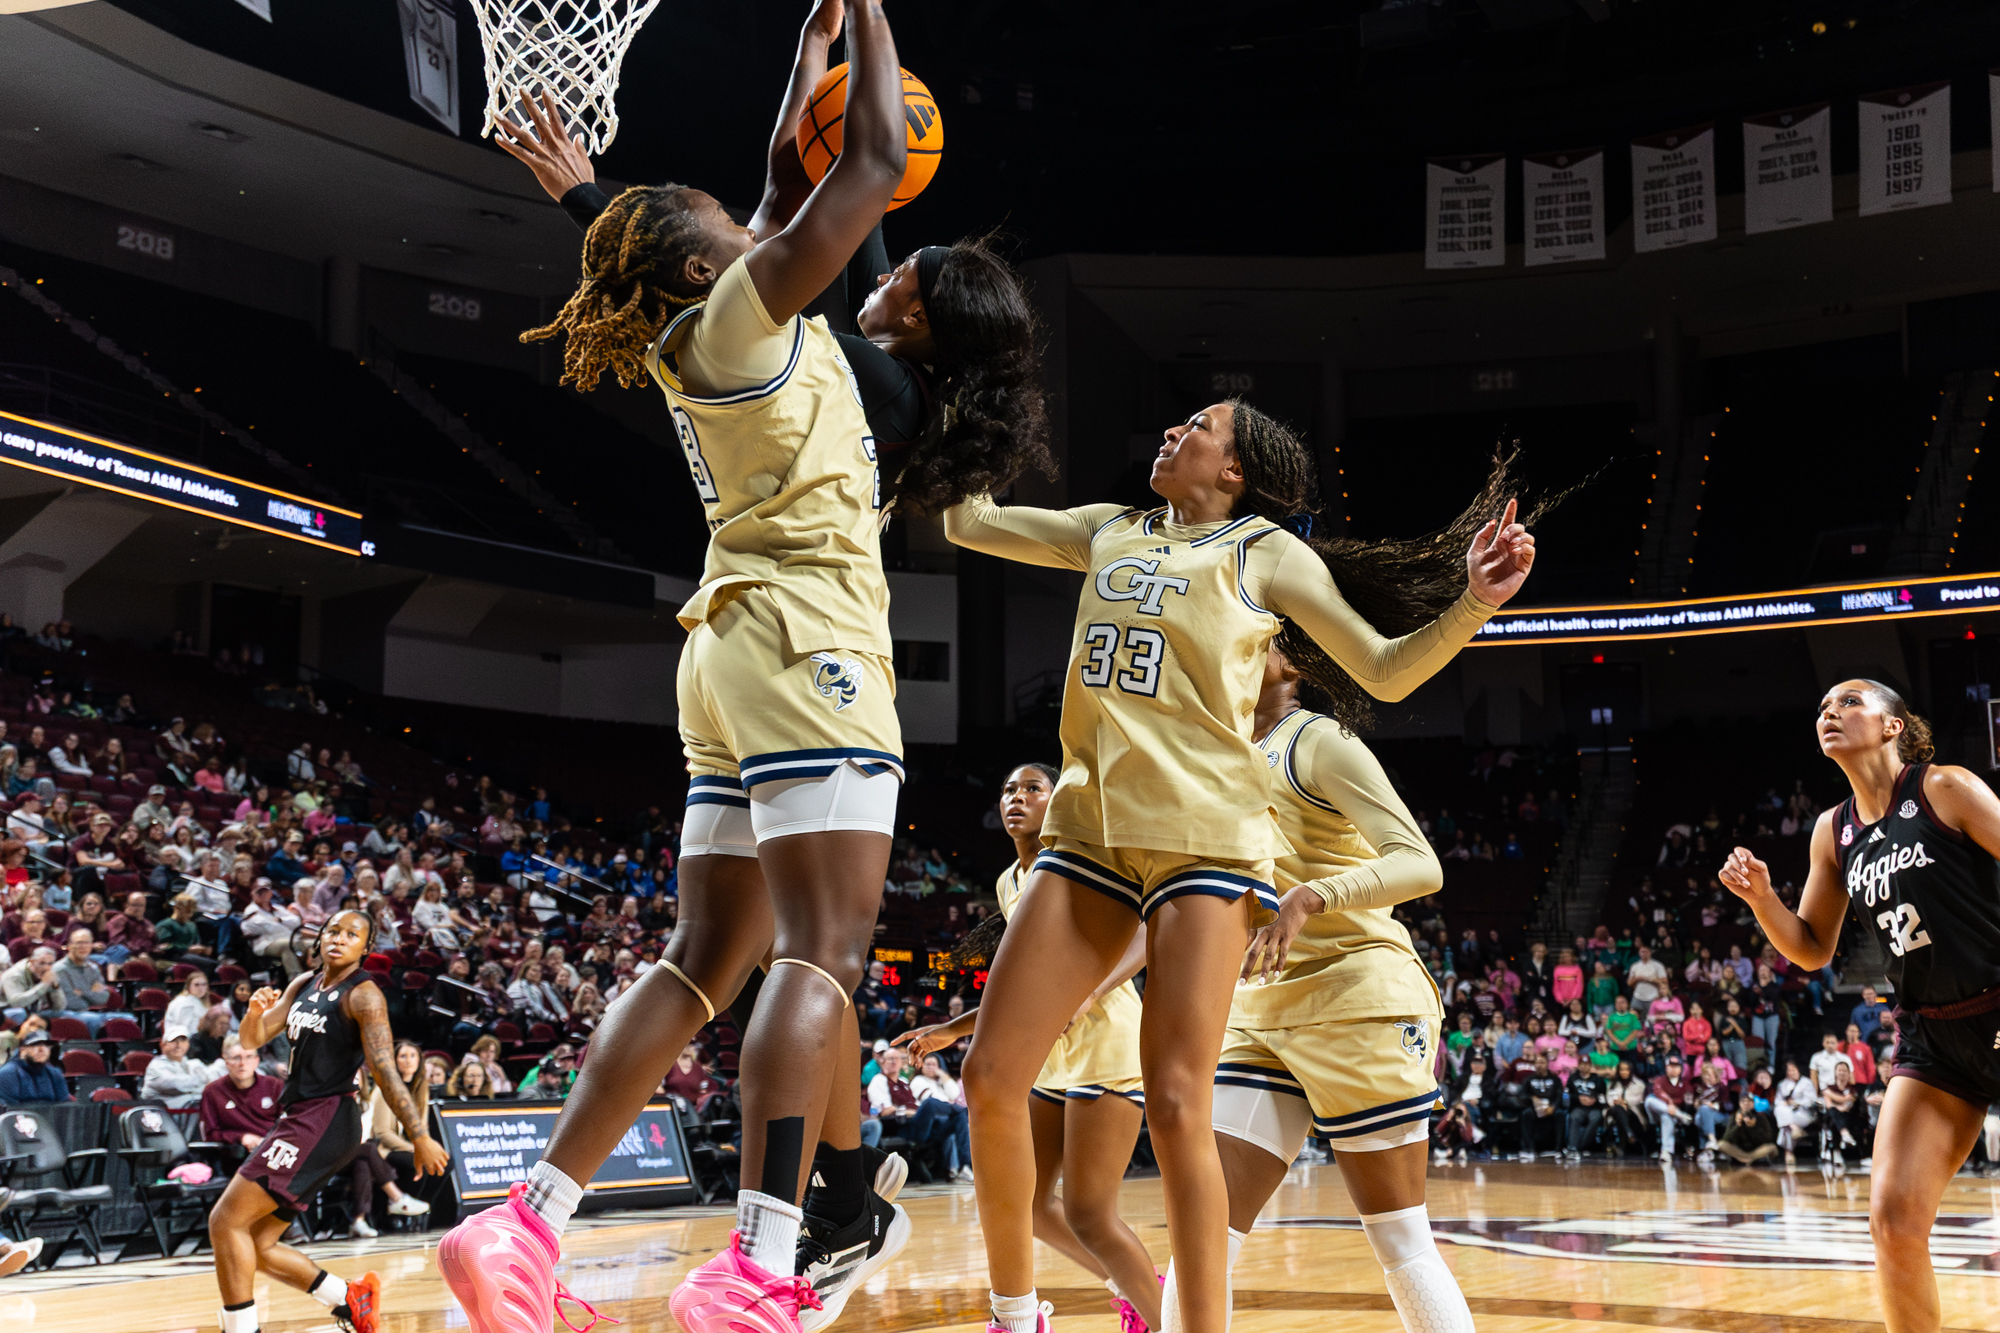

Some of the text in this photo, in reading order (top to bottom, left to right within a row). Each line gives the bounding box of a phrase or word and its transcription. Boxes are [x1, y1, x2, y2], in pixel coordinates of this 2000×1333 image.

[1886, 142, 1923, 161] 1985
[1884, 177, 1922, 196] 1997
[116, 225, 175, 261] 208
[428, 291, 481, 321] 209
[3, 432, 239, 507] care provider of Texas A&M Athletics.
[1095, 556, 1190, 616] GT
[1941, 585, 2000, 602] Proud to
[1483, 621, 1504, 634] the
[1505, 619, 1549, 633] official
[1549, 618, 1590, 631] health
[1590, 618, 1618, 628] care
[1618, 614, 1671, 630] provider
[1671, 611, 1685, 625] of
[1686, 610, 1722, 623] Texas
[1723, 607, 1754, 620] A&M
[1755, 601, 1815, 617] Athletics.
[1081, 623, 1166, 698] 33
[1847, 841, 1936, 907] Aggies
[1876, 903, 1932, 957] 32
[456, 1123, 490, 1137] Proud
[460, 1137, 501, 1152] official
[536, 1137, 549, 1149] ca
